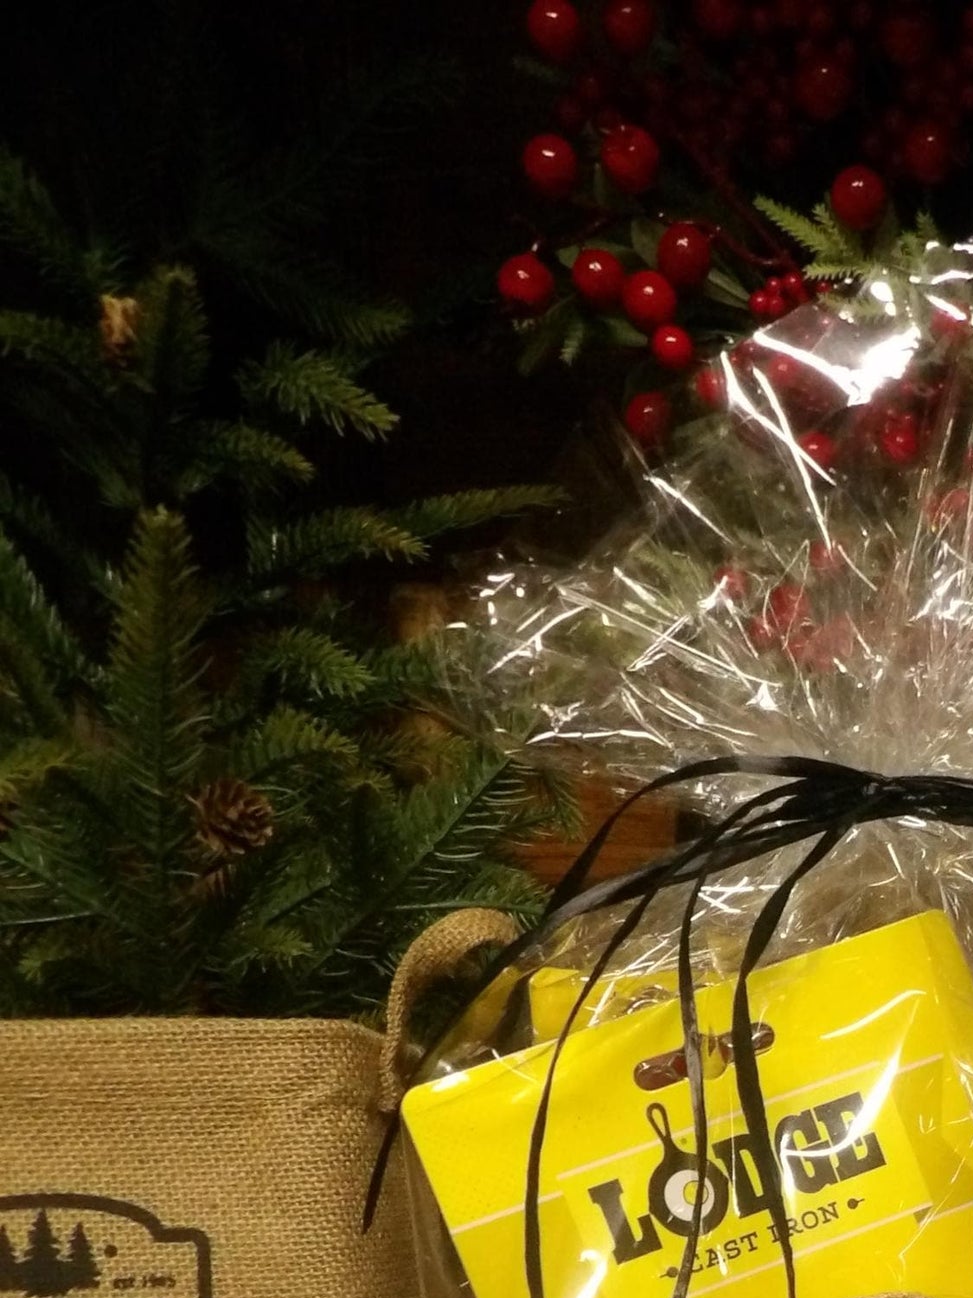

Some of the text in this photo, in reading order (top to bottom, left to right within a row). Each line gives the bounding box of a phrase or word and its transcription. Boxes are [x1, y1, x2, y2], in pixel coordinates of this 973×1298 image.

[587, 1091, 887, 1266] LODGE
[689, 1201, 841, 1274] CAST IRON
